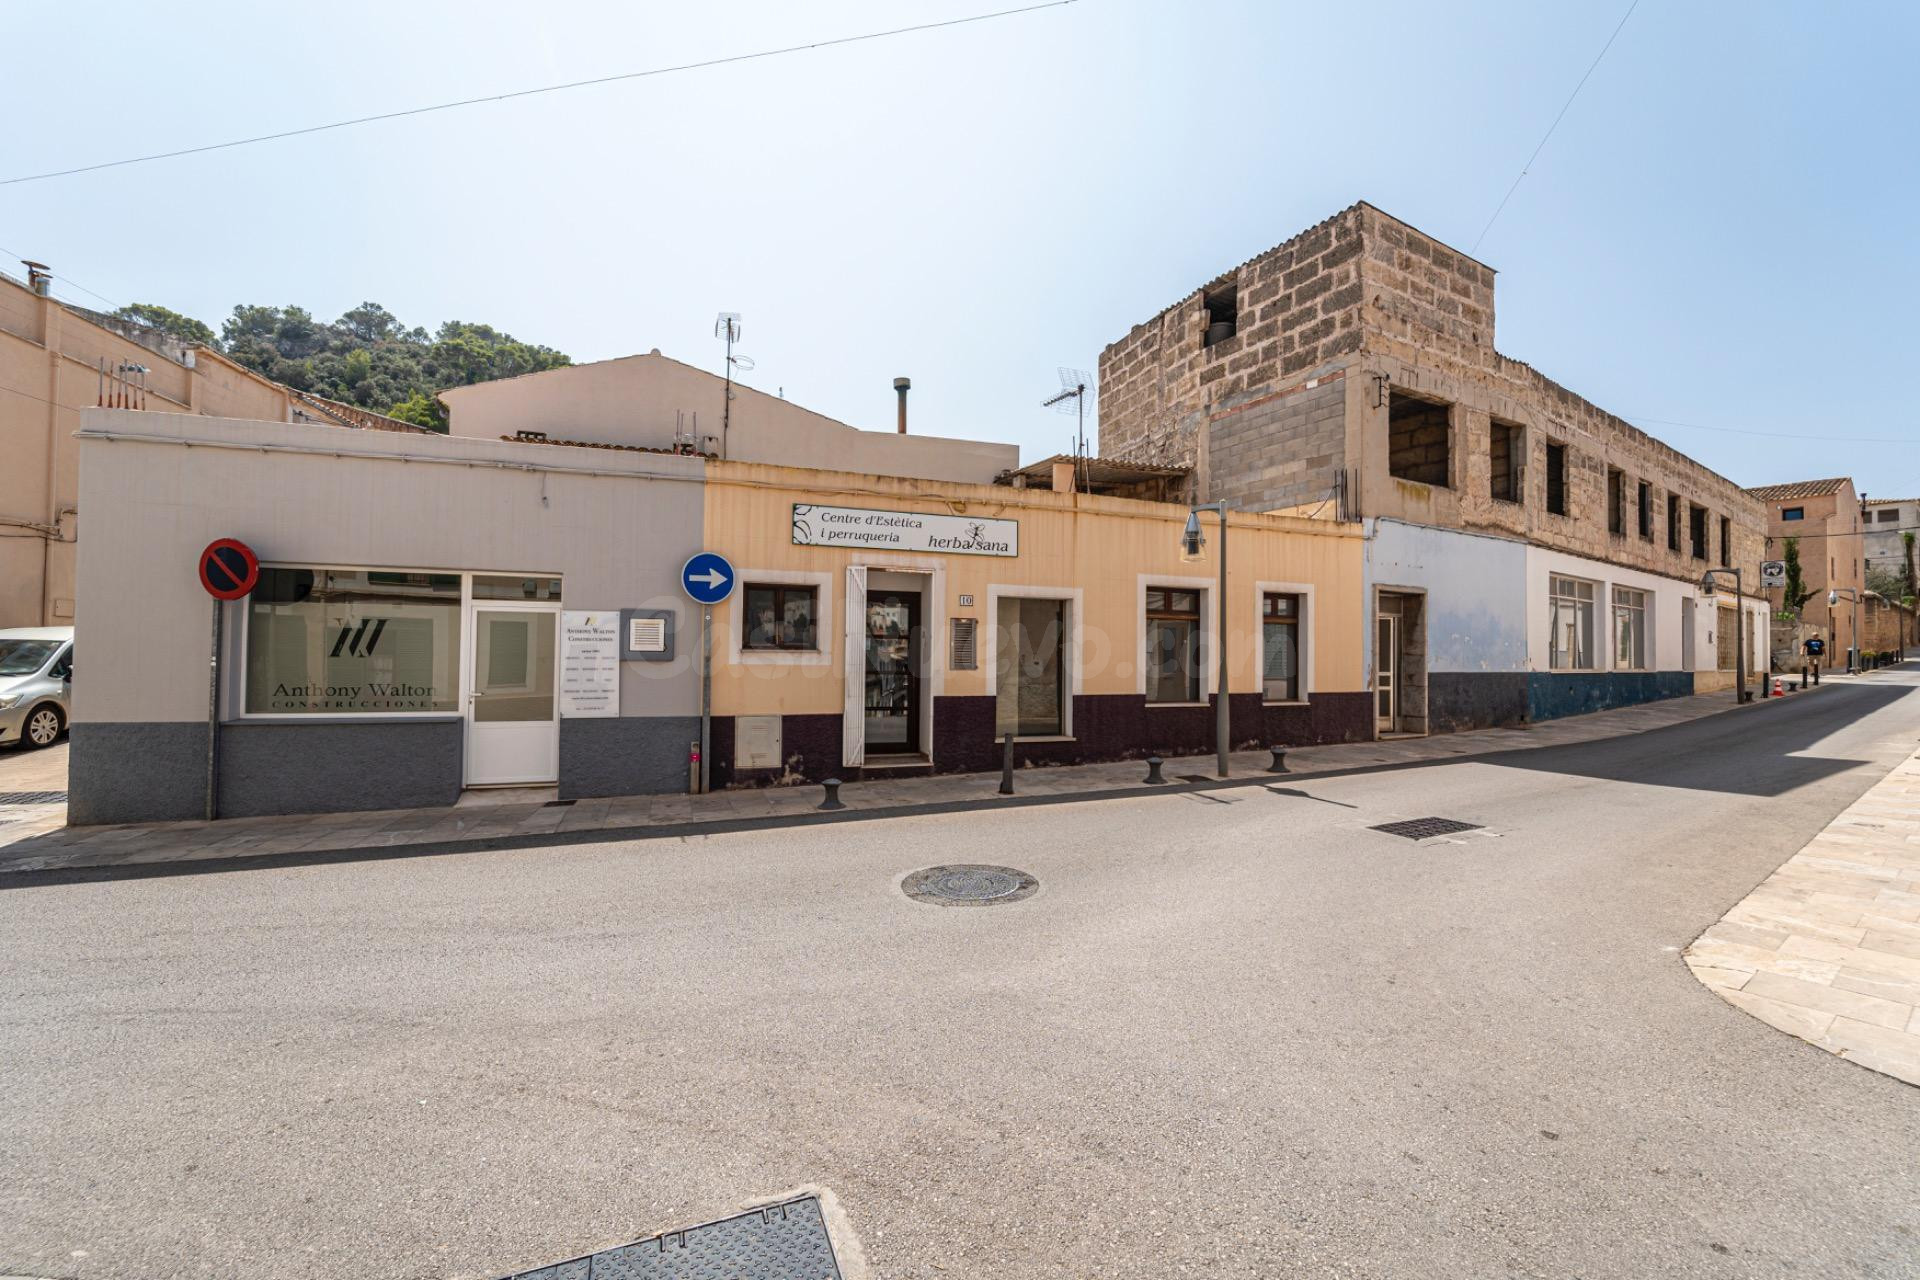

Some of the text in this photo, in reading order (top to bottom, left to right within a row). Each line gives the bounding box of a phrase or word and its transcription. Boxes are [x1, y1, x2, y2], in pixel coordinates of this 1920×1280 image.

[821, 512, 923, 529] Centre d'Estètica
[820, 528, 900, 543] i perruqueria
[928, 535, 1009, 552] herba sana
[273, 682, 437, 702] Anthony Walton
[271, 700, 439, 709] CONSTRUCCIONES
